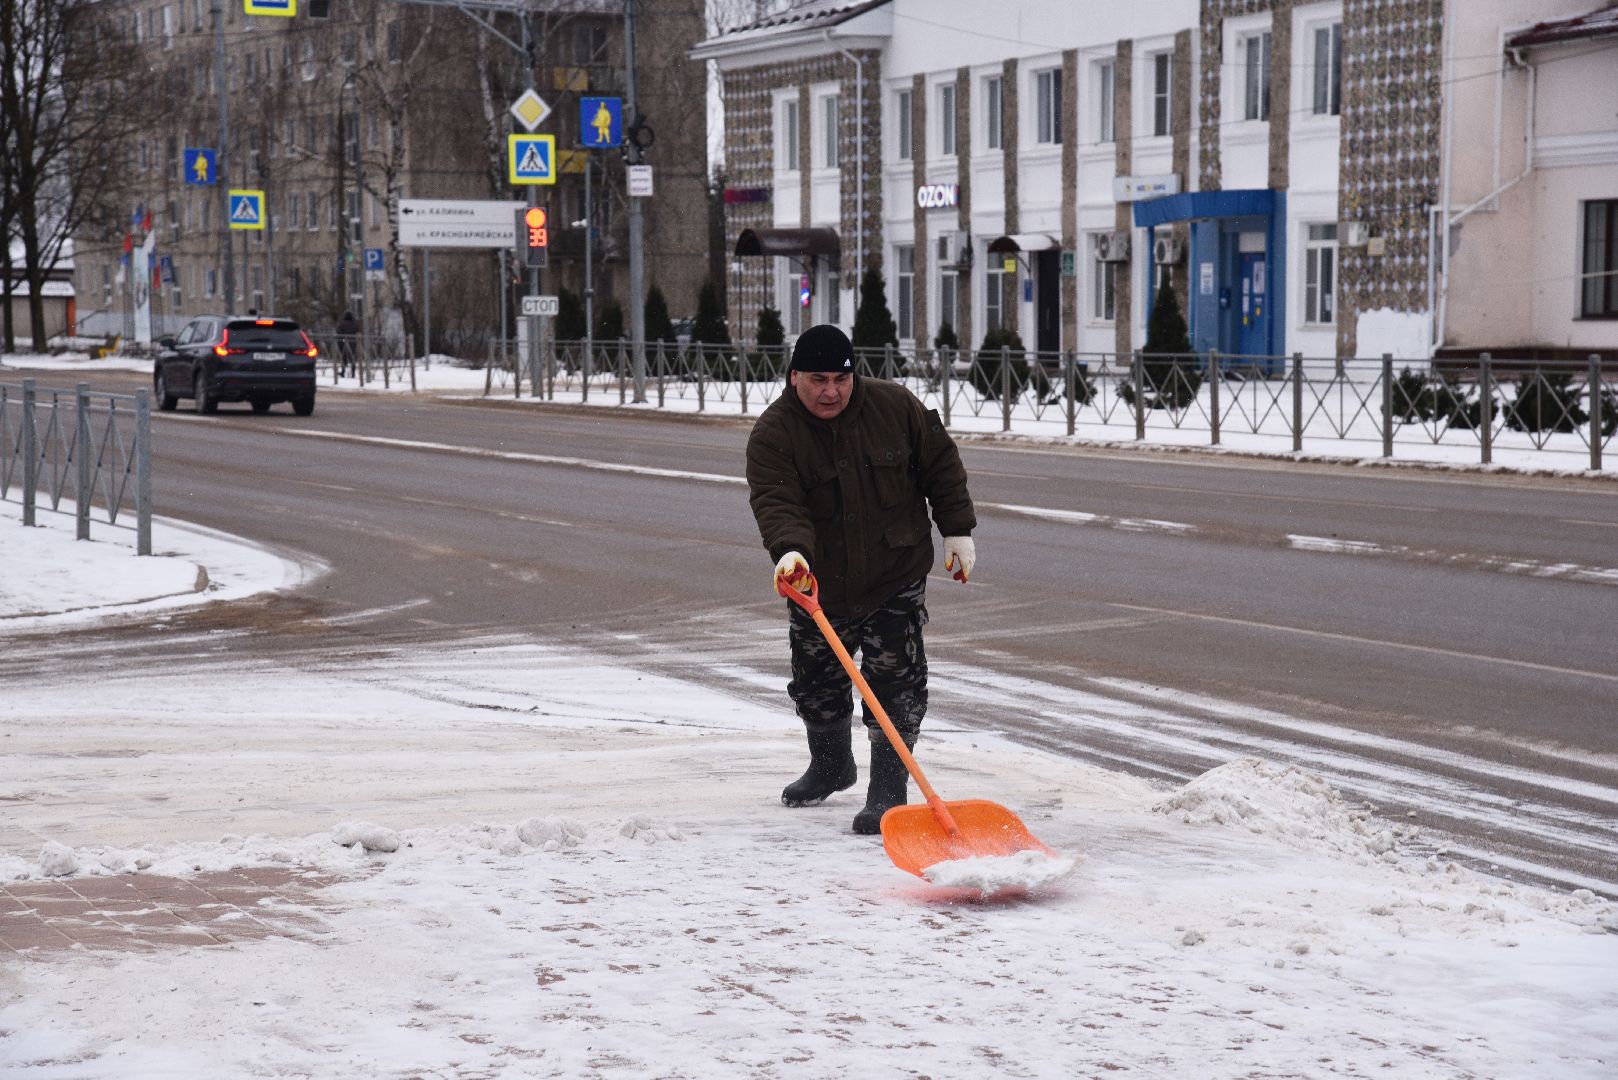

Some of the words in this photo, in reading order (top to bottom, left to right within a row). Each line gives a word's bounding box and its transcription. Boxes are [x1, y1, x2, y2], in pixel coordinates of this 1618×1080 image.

[918, 185, 955, 207] OZON
[367, 250, 379, 268] P
[523, 300, 558, 312] СТОП
